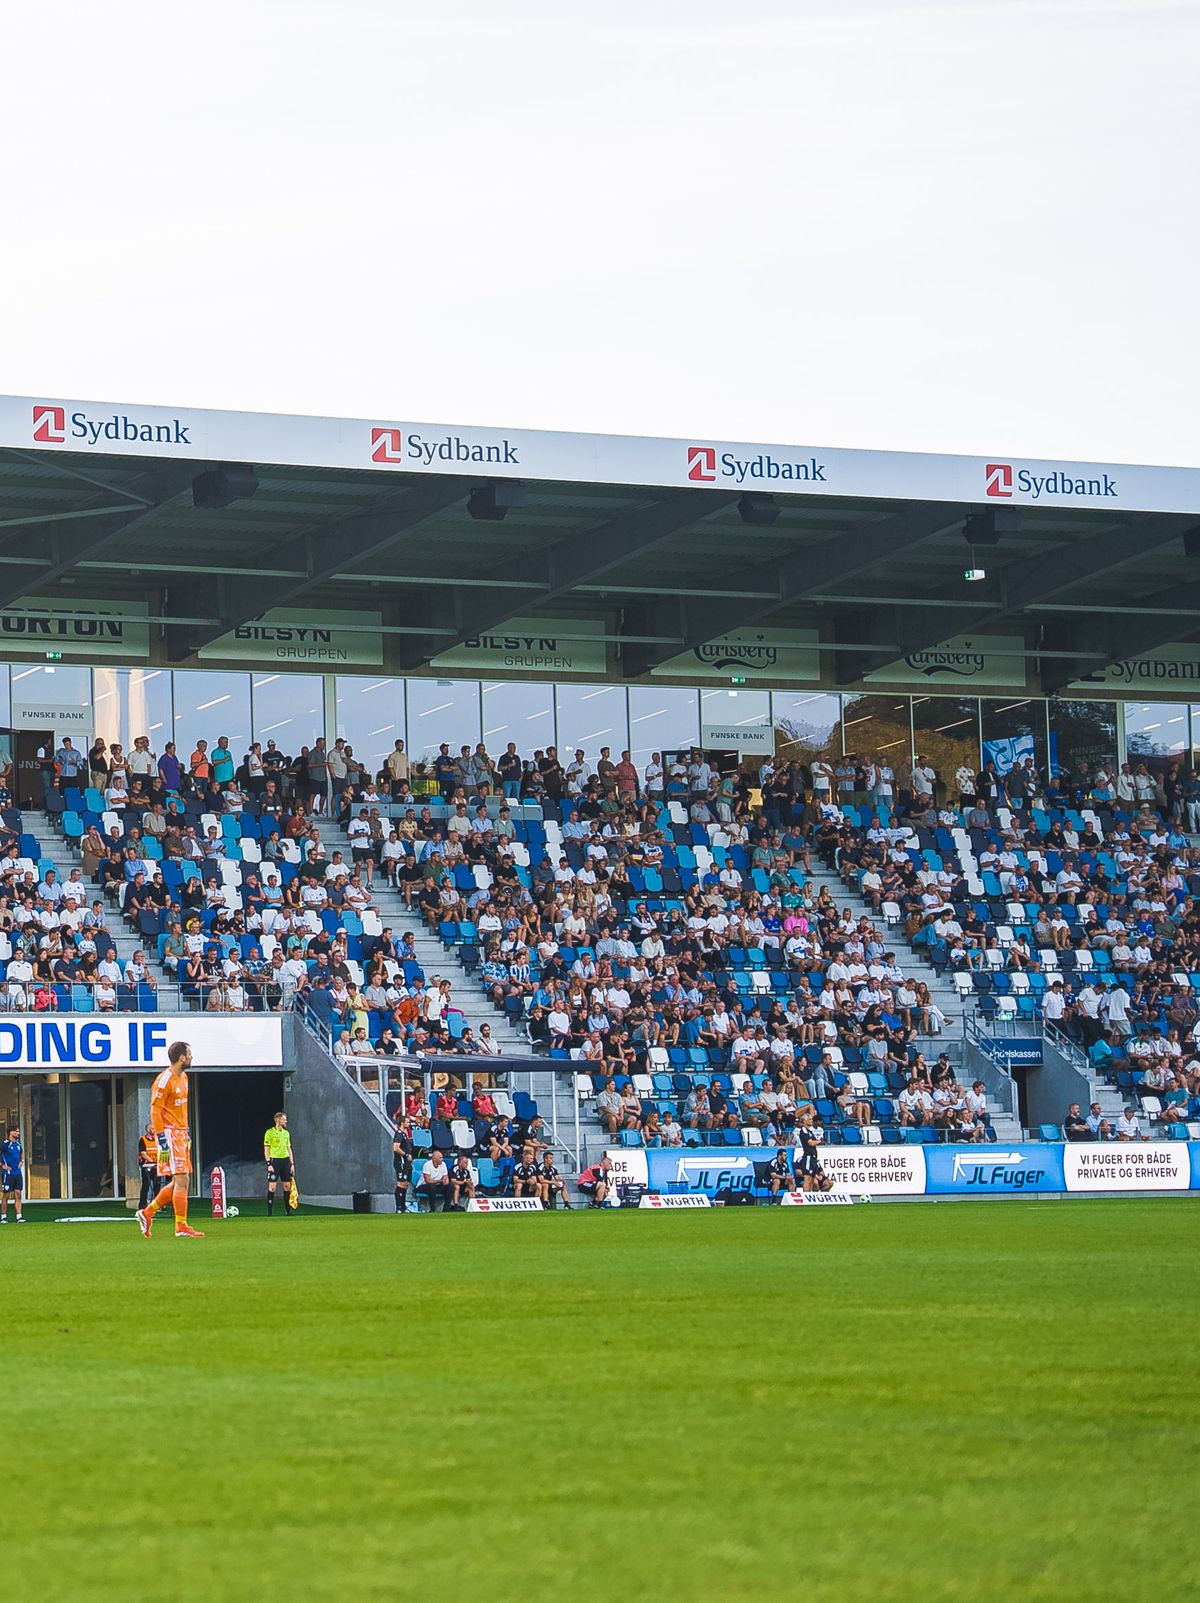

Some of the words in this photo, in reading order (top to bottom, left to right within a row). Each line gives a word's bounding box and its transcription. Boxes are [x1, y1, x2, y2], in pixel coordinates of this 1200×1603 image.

[71, 412, 191, 446] Sydbank
[407, 433, 519, 465] Sydbank
[721, 453, 827, 483] Sydbank
[1017, 469, 1118, 498] Sydbank
[276, 646, 347, 660] GRUPPEN
[504, 655, 572, 668] GRUPPEN
[59, 711, 84, 720] BANK
[742, 732, 765, 741] BANK
[128, 1022, 168, 1062] IF
[823, 1158, 856, 1169] FUGER
[858, 1158, 877, 1168] FOR
[880, 1155, 907, 1168] BÅDE
[1080, 1155, 1090, 1165] VI
[1092, 1154, 1123, 1165] FUGER
[1125, 1154, 1144, 1164] FOR
[1147, 1152, 1172, 1164] BÅDE
[851, 1172, 866, 1183] OG
[868, 1171, 913, 1182] ERHVERV
[967, 1166, 988, 1185] JL
[990, 1166, 1045, 1188] Fuger
[1077, 1169, 1116, 1179] PRIVATE
[1118, 1168, 1133, 1178] OG
[1135, 1167, 1179, 1178] ERHVERV
[691, 1171, 713, 1189] JL
[716, 1171, 755, 1190] Fug
